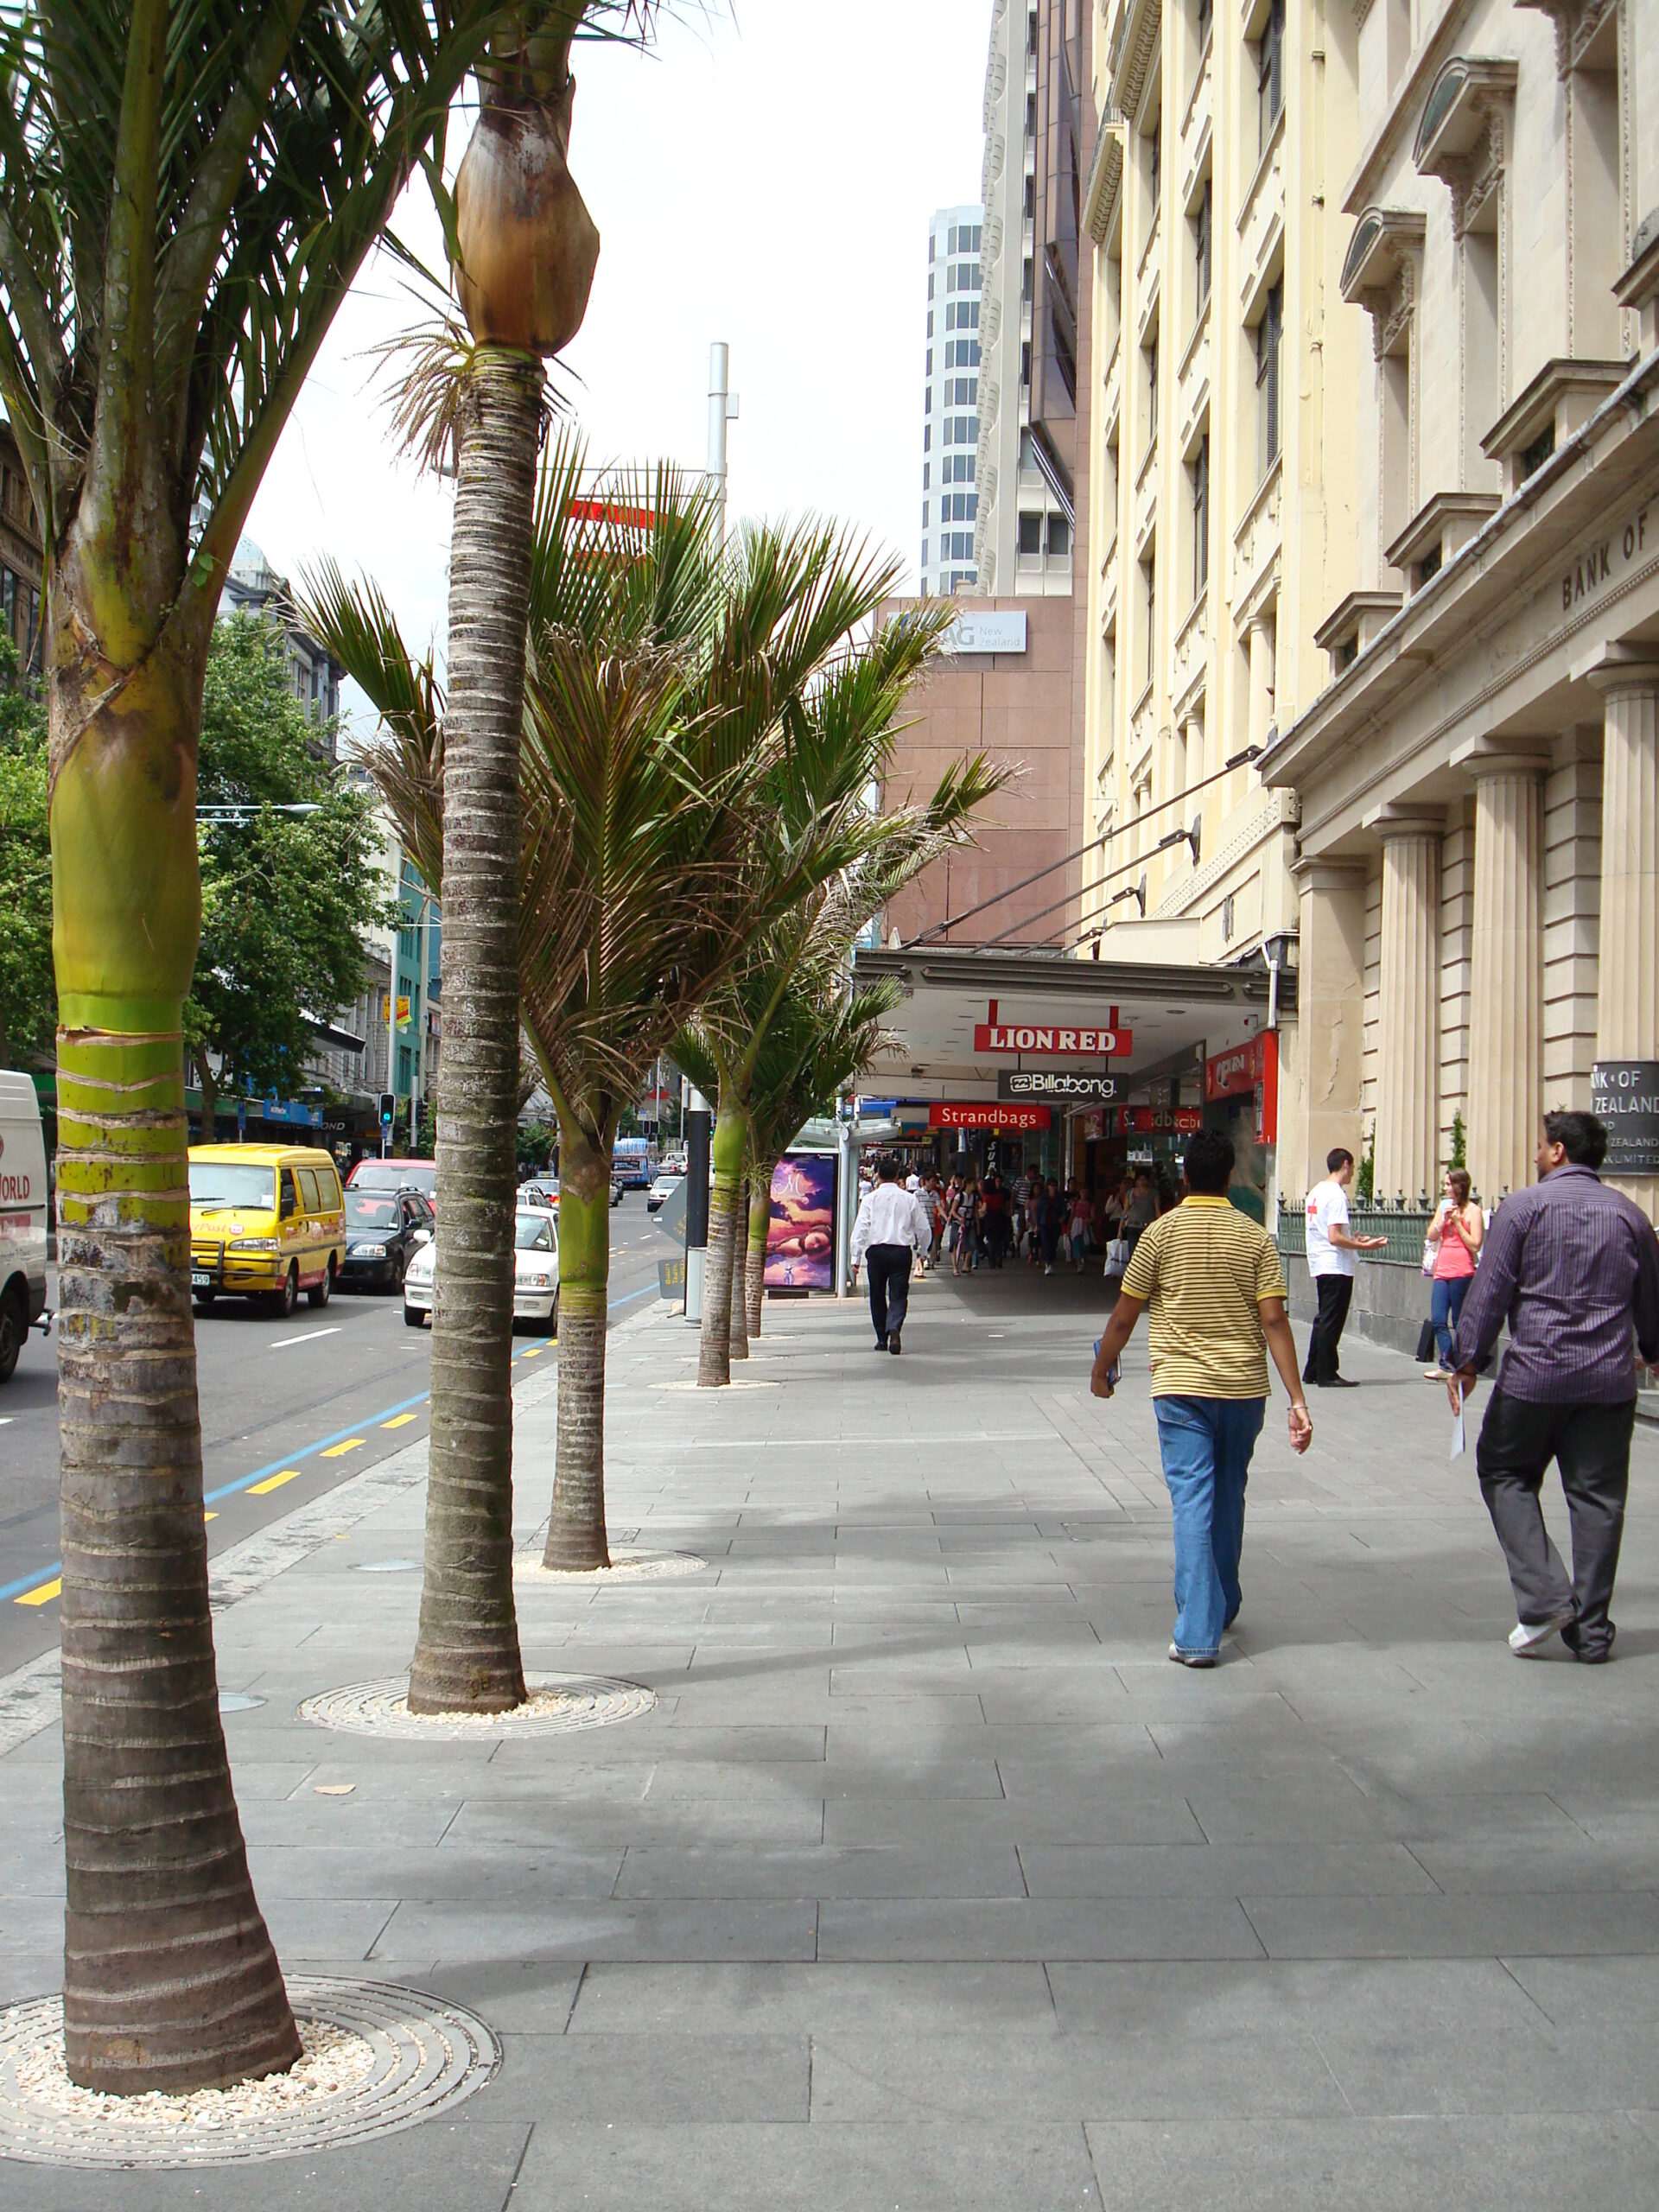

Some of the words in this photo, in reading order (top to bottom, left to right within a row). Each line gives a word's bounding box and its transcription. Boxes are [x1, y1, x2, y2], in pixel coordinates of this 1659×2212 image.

[1562, 542, 1611, 611] BANK
[1623, 512, 1648, 560] OF
[943, 626, 975, 645] AG
[980, 626, 1003, 636] New
[979, 637, 1020, 646] Zealand
[989, 1028, 1054, 1050] LION
[1058, 1030, 1116, 1052] RED
[1618, 1071, 1641, 1088] OF
[942, 1108, 1037, 1128] Strandbags
[1611, 1138, 1659, 1147] ZEALAND
[0, 1174, 30, 1200] ORLD
[193, 1275, 208, 1285] 459
